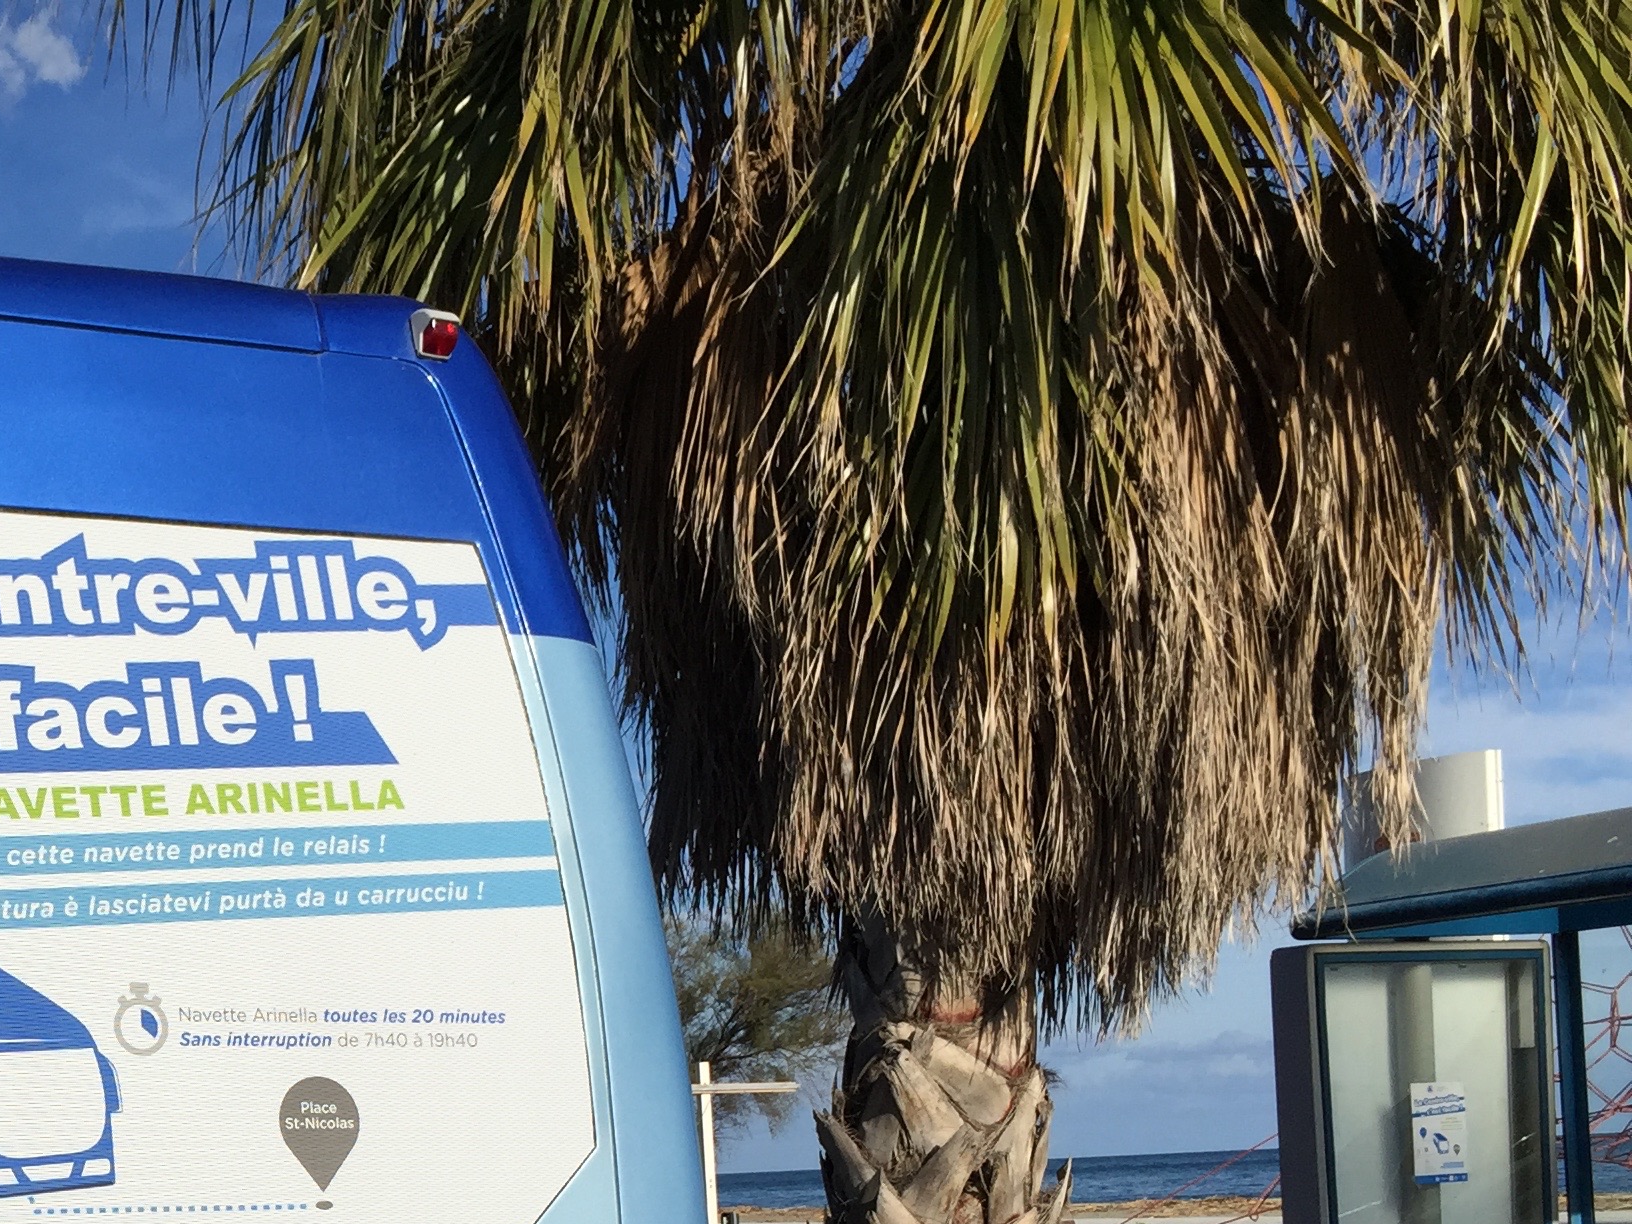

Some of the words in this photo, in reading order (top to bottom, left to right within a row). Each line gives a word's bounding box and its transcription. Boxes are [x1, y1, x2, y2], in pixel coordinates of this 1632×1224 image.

[284, 674, 315, 742] !
[185, 779, 405, 815] ARINELLA
[7, 842, 74, 866] cette
[84, 840, 180, 864] navette
[189, 836, 264, 862] prend
[273, 836, 294, 858] le
[303, 834, 370, 857] relais
[378, 834, 386, 853] !
[64, 894, 79, 917] è
[89, 889, 210, 917] lasciatevi
[219, 886, 287, 914] purtà
[295, 886, 325, 908] da
[335, 889, 348, 906] u
[357, 881, 468, 905] carrucciu
[475, 881, 485, 900] !
[179, 1007, 246, 1023] Navette
[253, 1007, 318, 1023] Arinella
[323, 1008, 377, 1023] toutes
[383, 1008, 406, 1023] les
[412, 1009, 434, 1023] 20
[439, 1008, 506, 1024] minutes
[180, 1032, 221, 1047] Sans
[227, 1031, 332, 1050] interruption
[338, 1032, 359, 1047] de
[366, 1032, 408, 1047] 7h40
[414, 1032, 423, 1047] à
[429, 1032, 478, 1047] 19h40
[300, 1101, 337, 1114] Place
[285, 1116, 354, 1130] St-Nicolas
